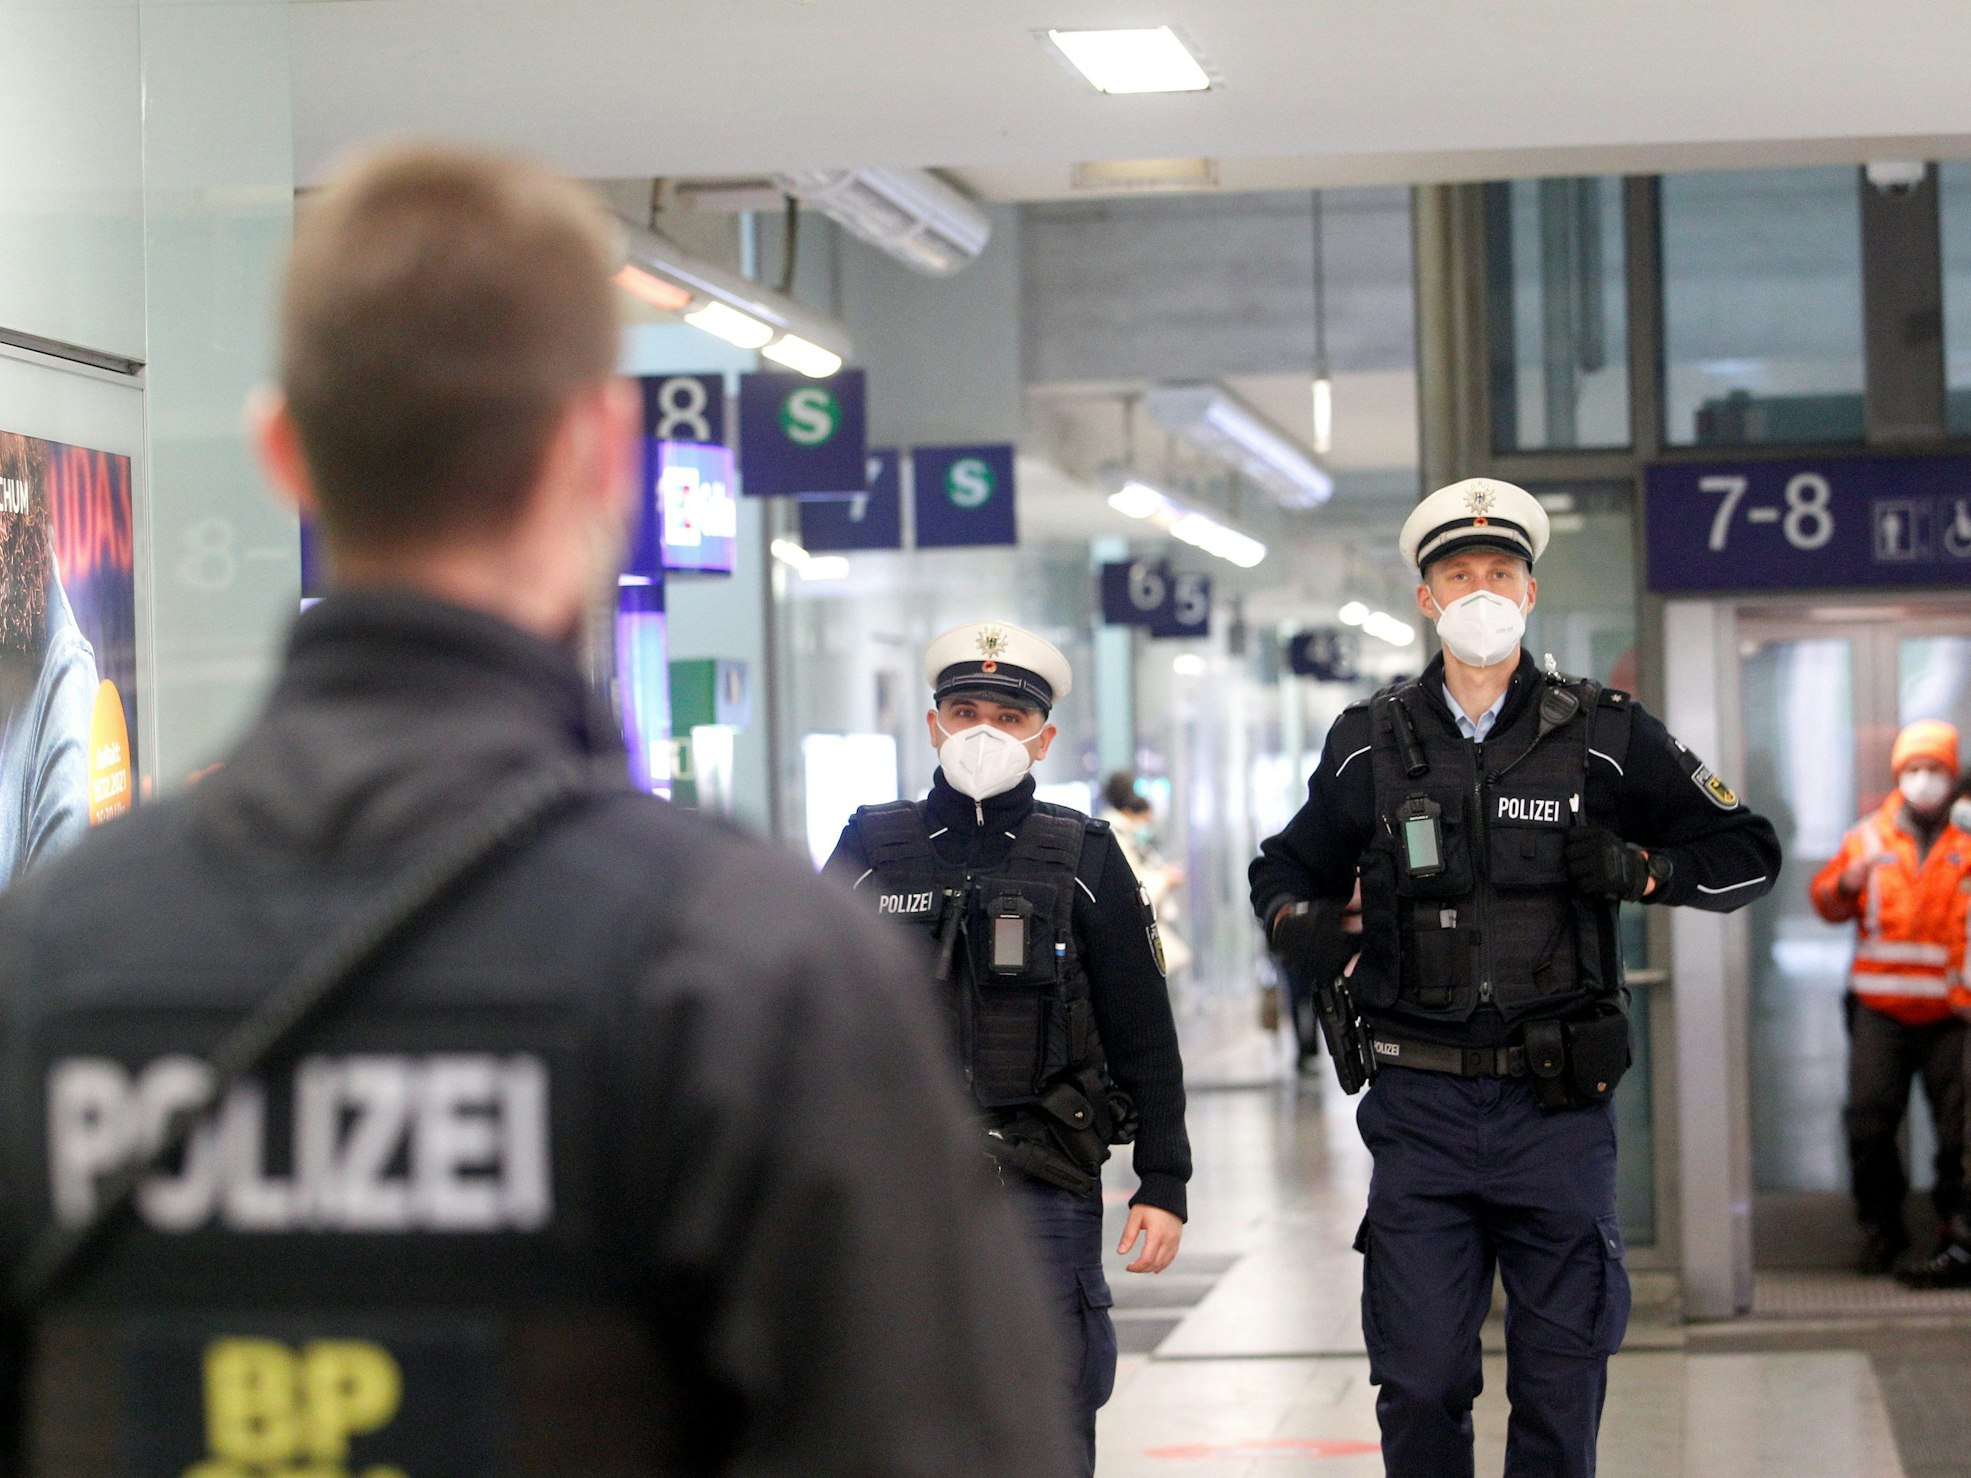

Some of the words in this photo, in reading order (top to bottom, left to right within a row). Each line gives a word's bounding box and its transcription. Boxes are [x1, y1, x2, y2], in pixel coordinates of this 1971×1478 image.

[785, 387, 835, 446] S
[948, 457, 993, 508] S
[1699, 472, 1834, 551] 7-8
[1128, 560, 1165, 612] 6
[1497, 796, 1560, 822] POLIZEI
[878, 891, 933, 914] POLIZEI
[47, 1053, 552, 1234] POLIZEI
[204, 1337, 401, 1463] BP
